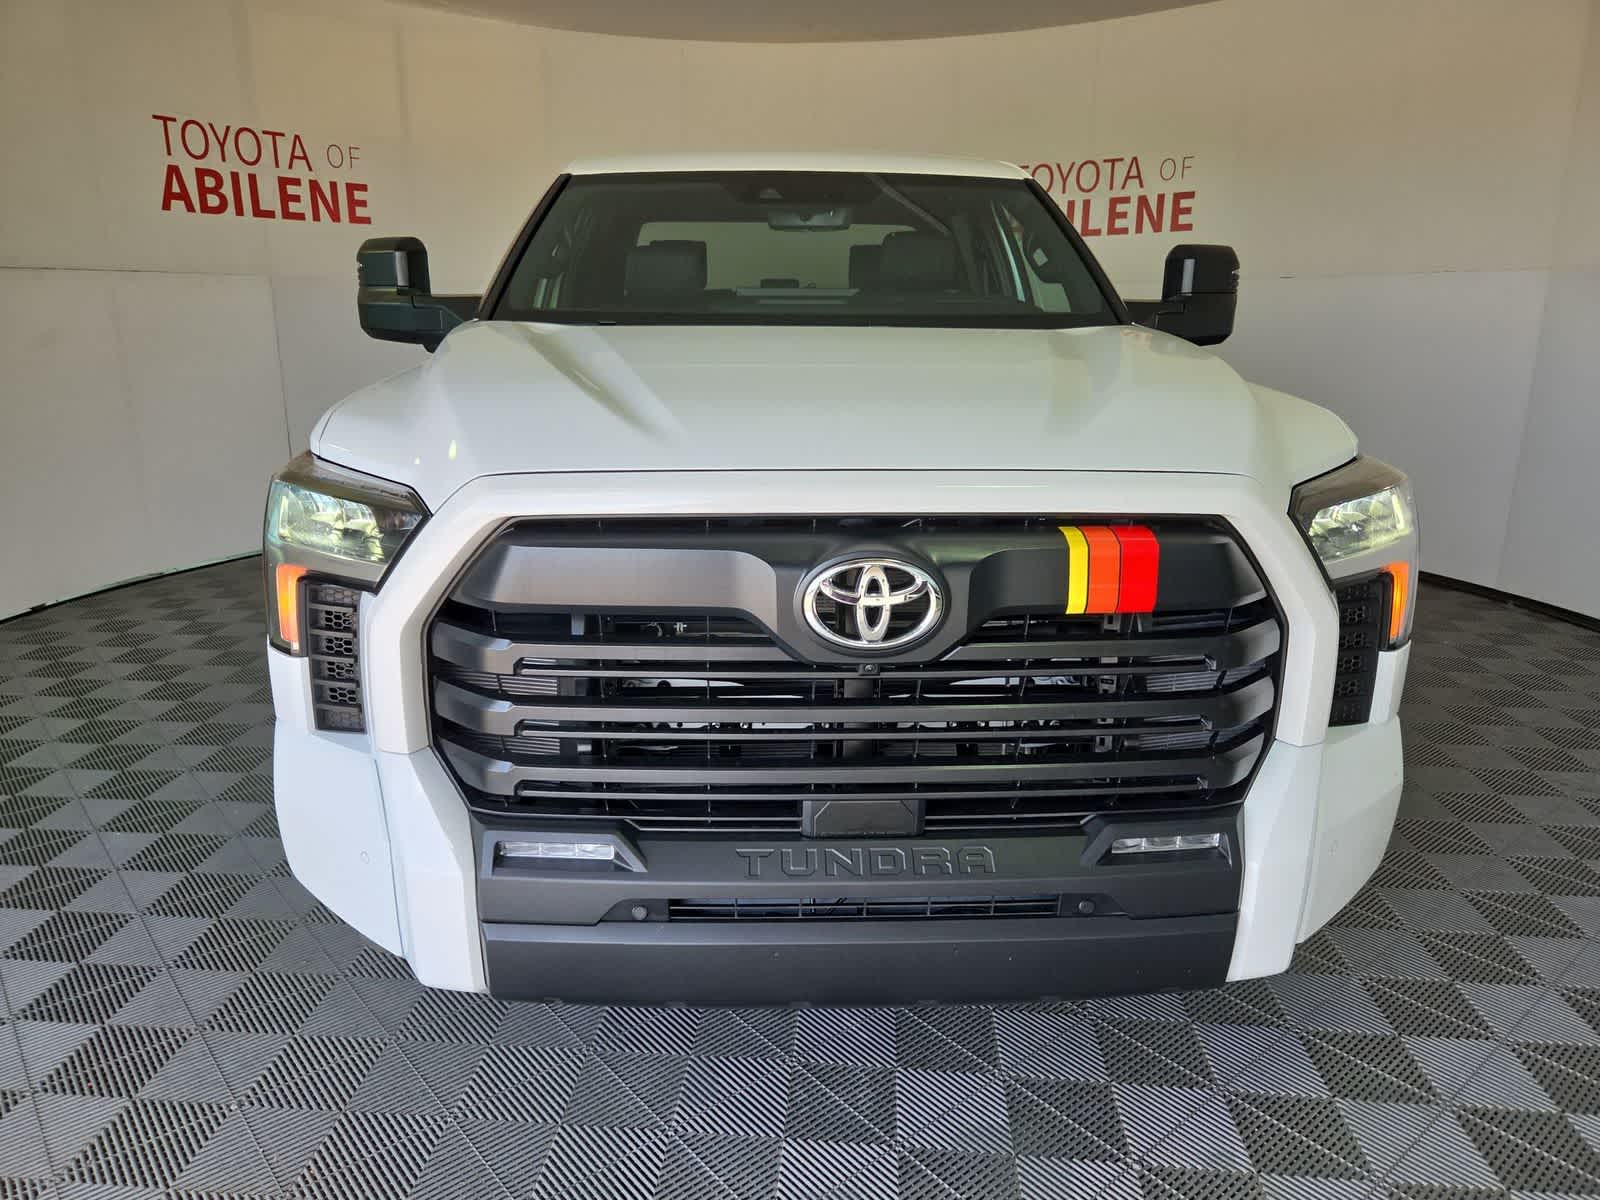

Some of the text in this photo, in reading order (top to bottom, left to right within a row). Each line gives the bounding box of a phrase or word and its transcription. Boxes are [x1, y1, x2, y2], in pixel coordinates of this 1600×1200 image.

[152, 114, 360, 171] TOYOTA OF
[161, 164, 371, 224] ABILENE
[1019, 156, 1194, 194] OYOTA OF
[1066, 191, 1195, 237] ILENE
[736, 846, 996, 877] TUNDRA
